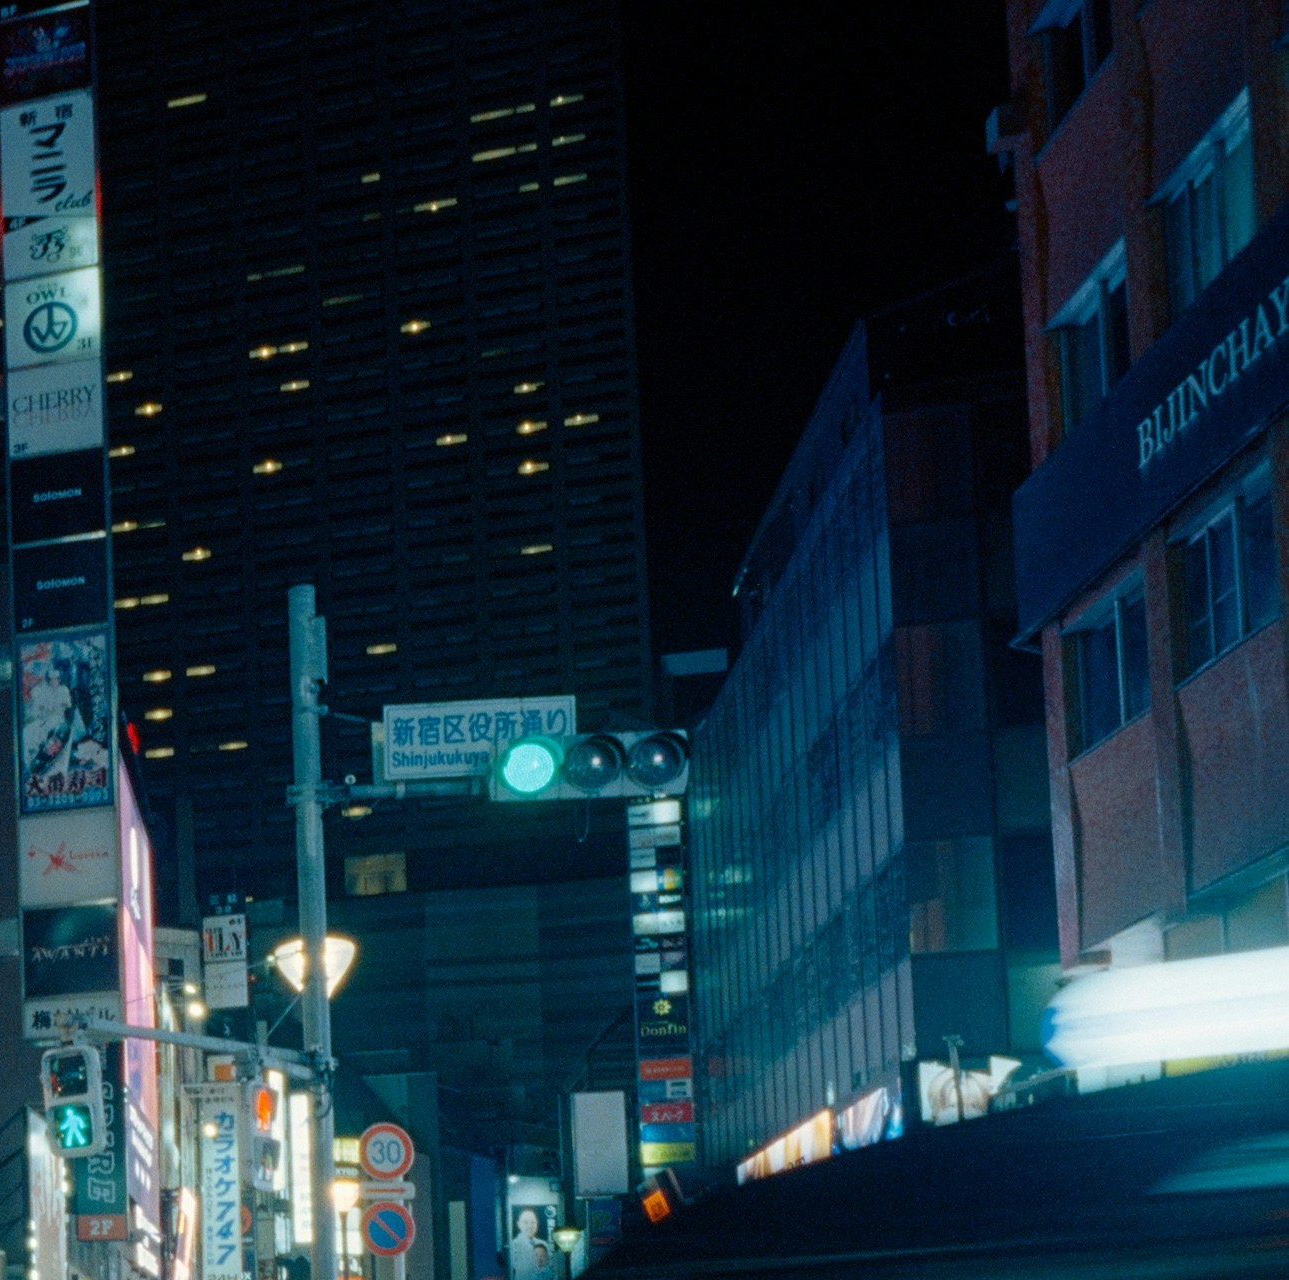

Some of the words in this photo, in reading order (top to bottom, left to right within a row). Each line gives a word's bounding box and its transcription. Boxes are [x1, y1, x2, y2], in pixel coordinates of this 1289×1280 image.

[29, 121, 69, 203] マニラ
[54, 191, 93, 213] club
[12, 385, 96, 414] CHERRY
[392, 708, 568, 746] 新宿区役所通り
[372, 1139, 402, 1165] 30
[213, 1111, 237, 1266] カラオケ747
